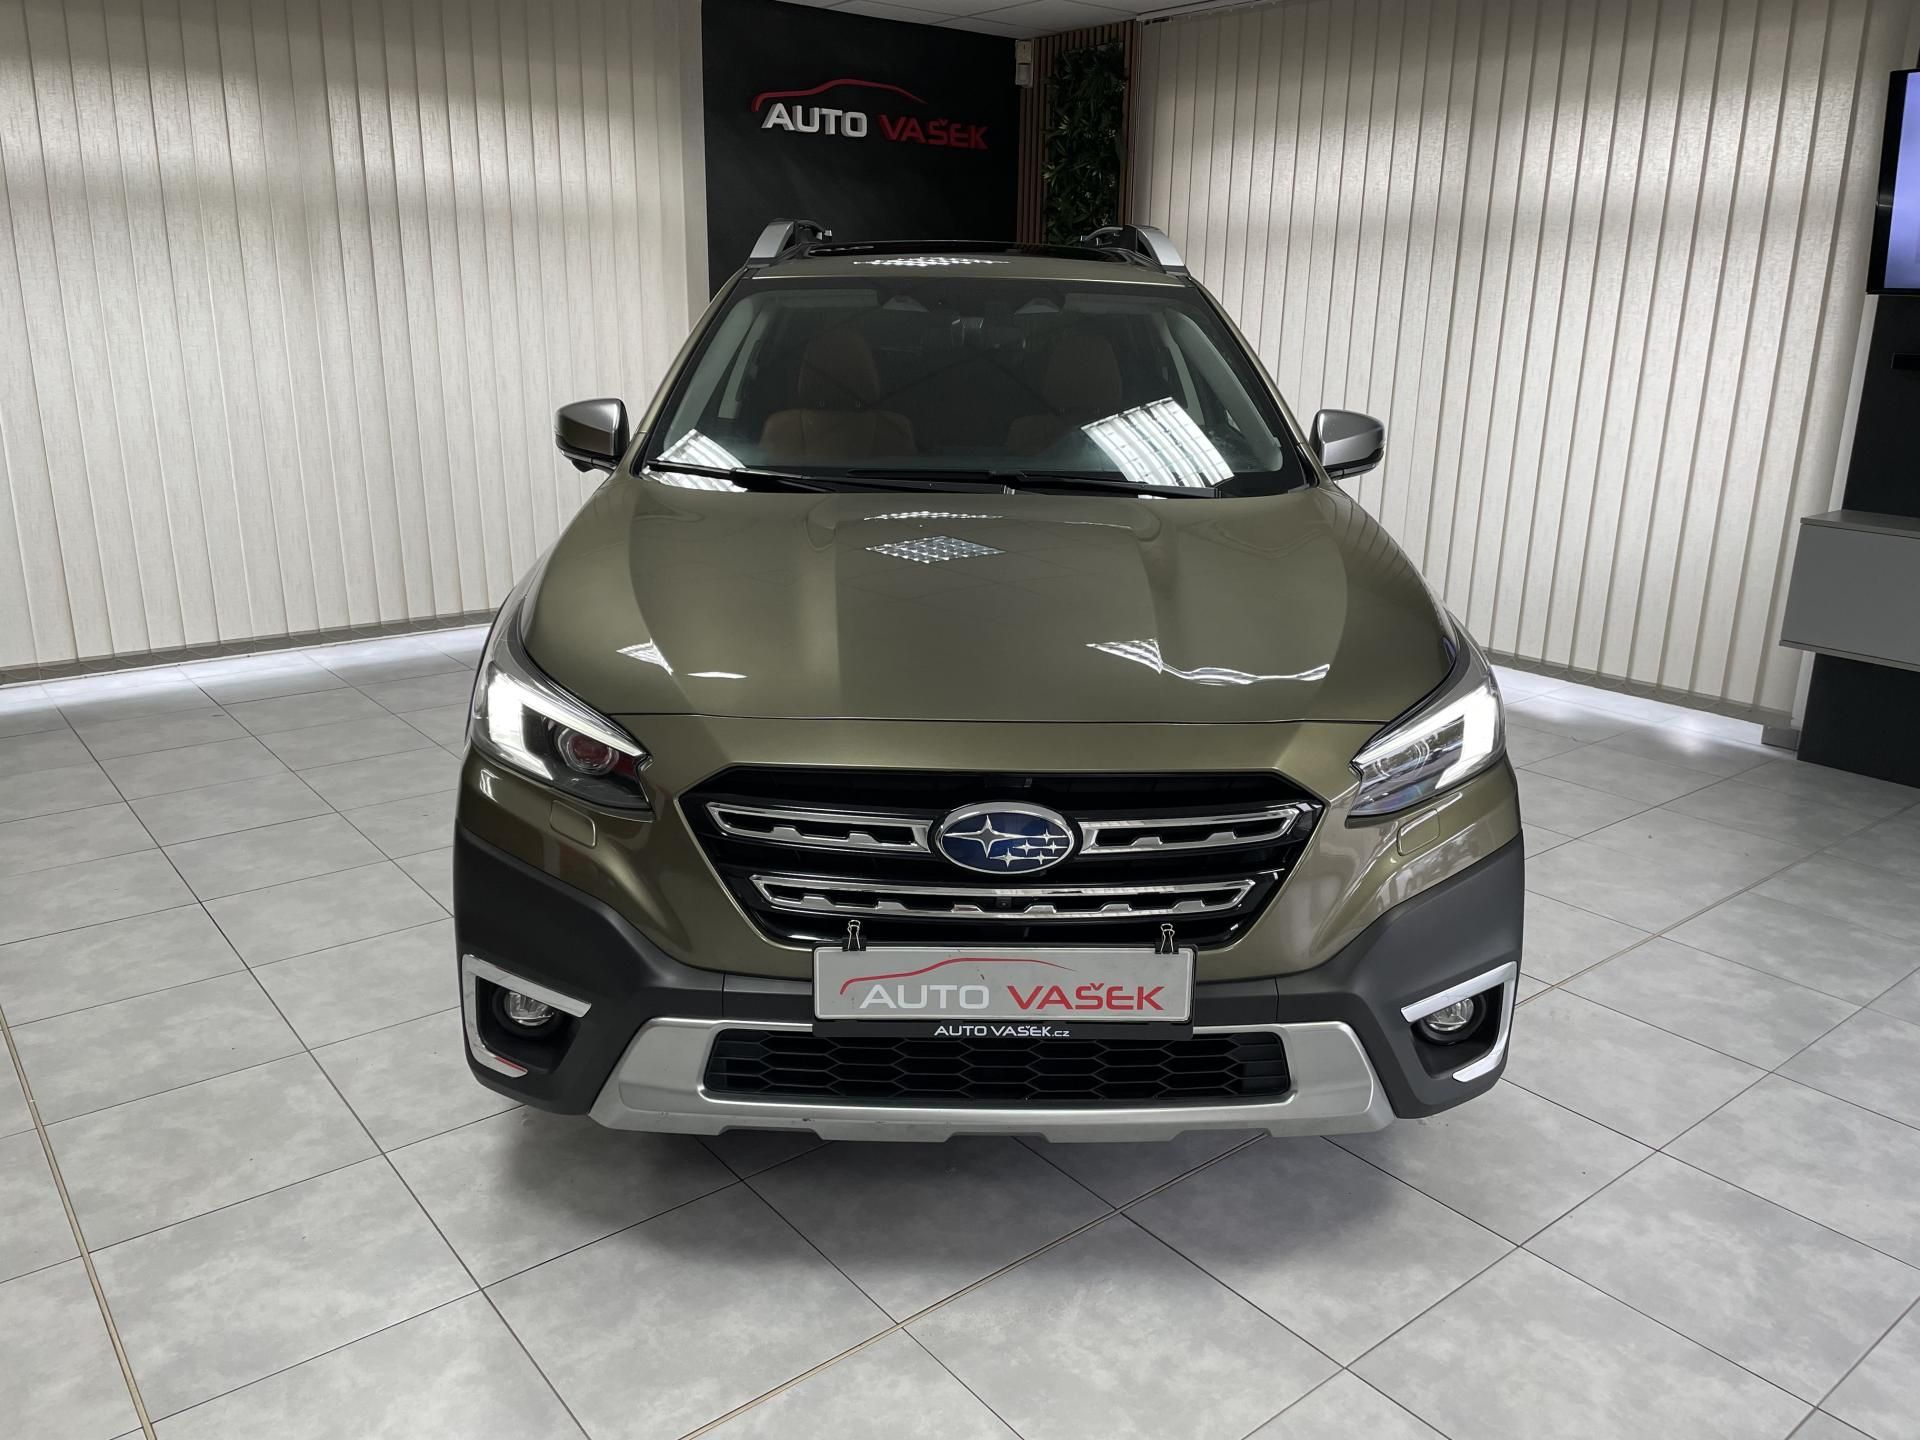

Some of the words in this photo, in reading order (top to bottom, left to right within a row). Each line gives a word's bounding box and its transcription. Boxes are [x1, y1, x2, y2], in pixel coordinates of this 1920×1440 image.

[761, 102, 868, 138] AUTO
[860, 984, 989, 1009] AUTO
[1006, 982, 1165, 1011] VAŠEK
[934, 1025, 987, 1037] AUTO
